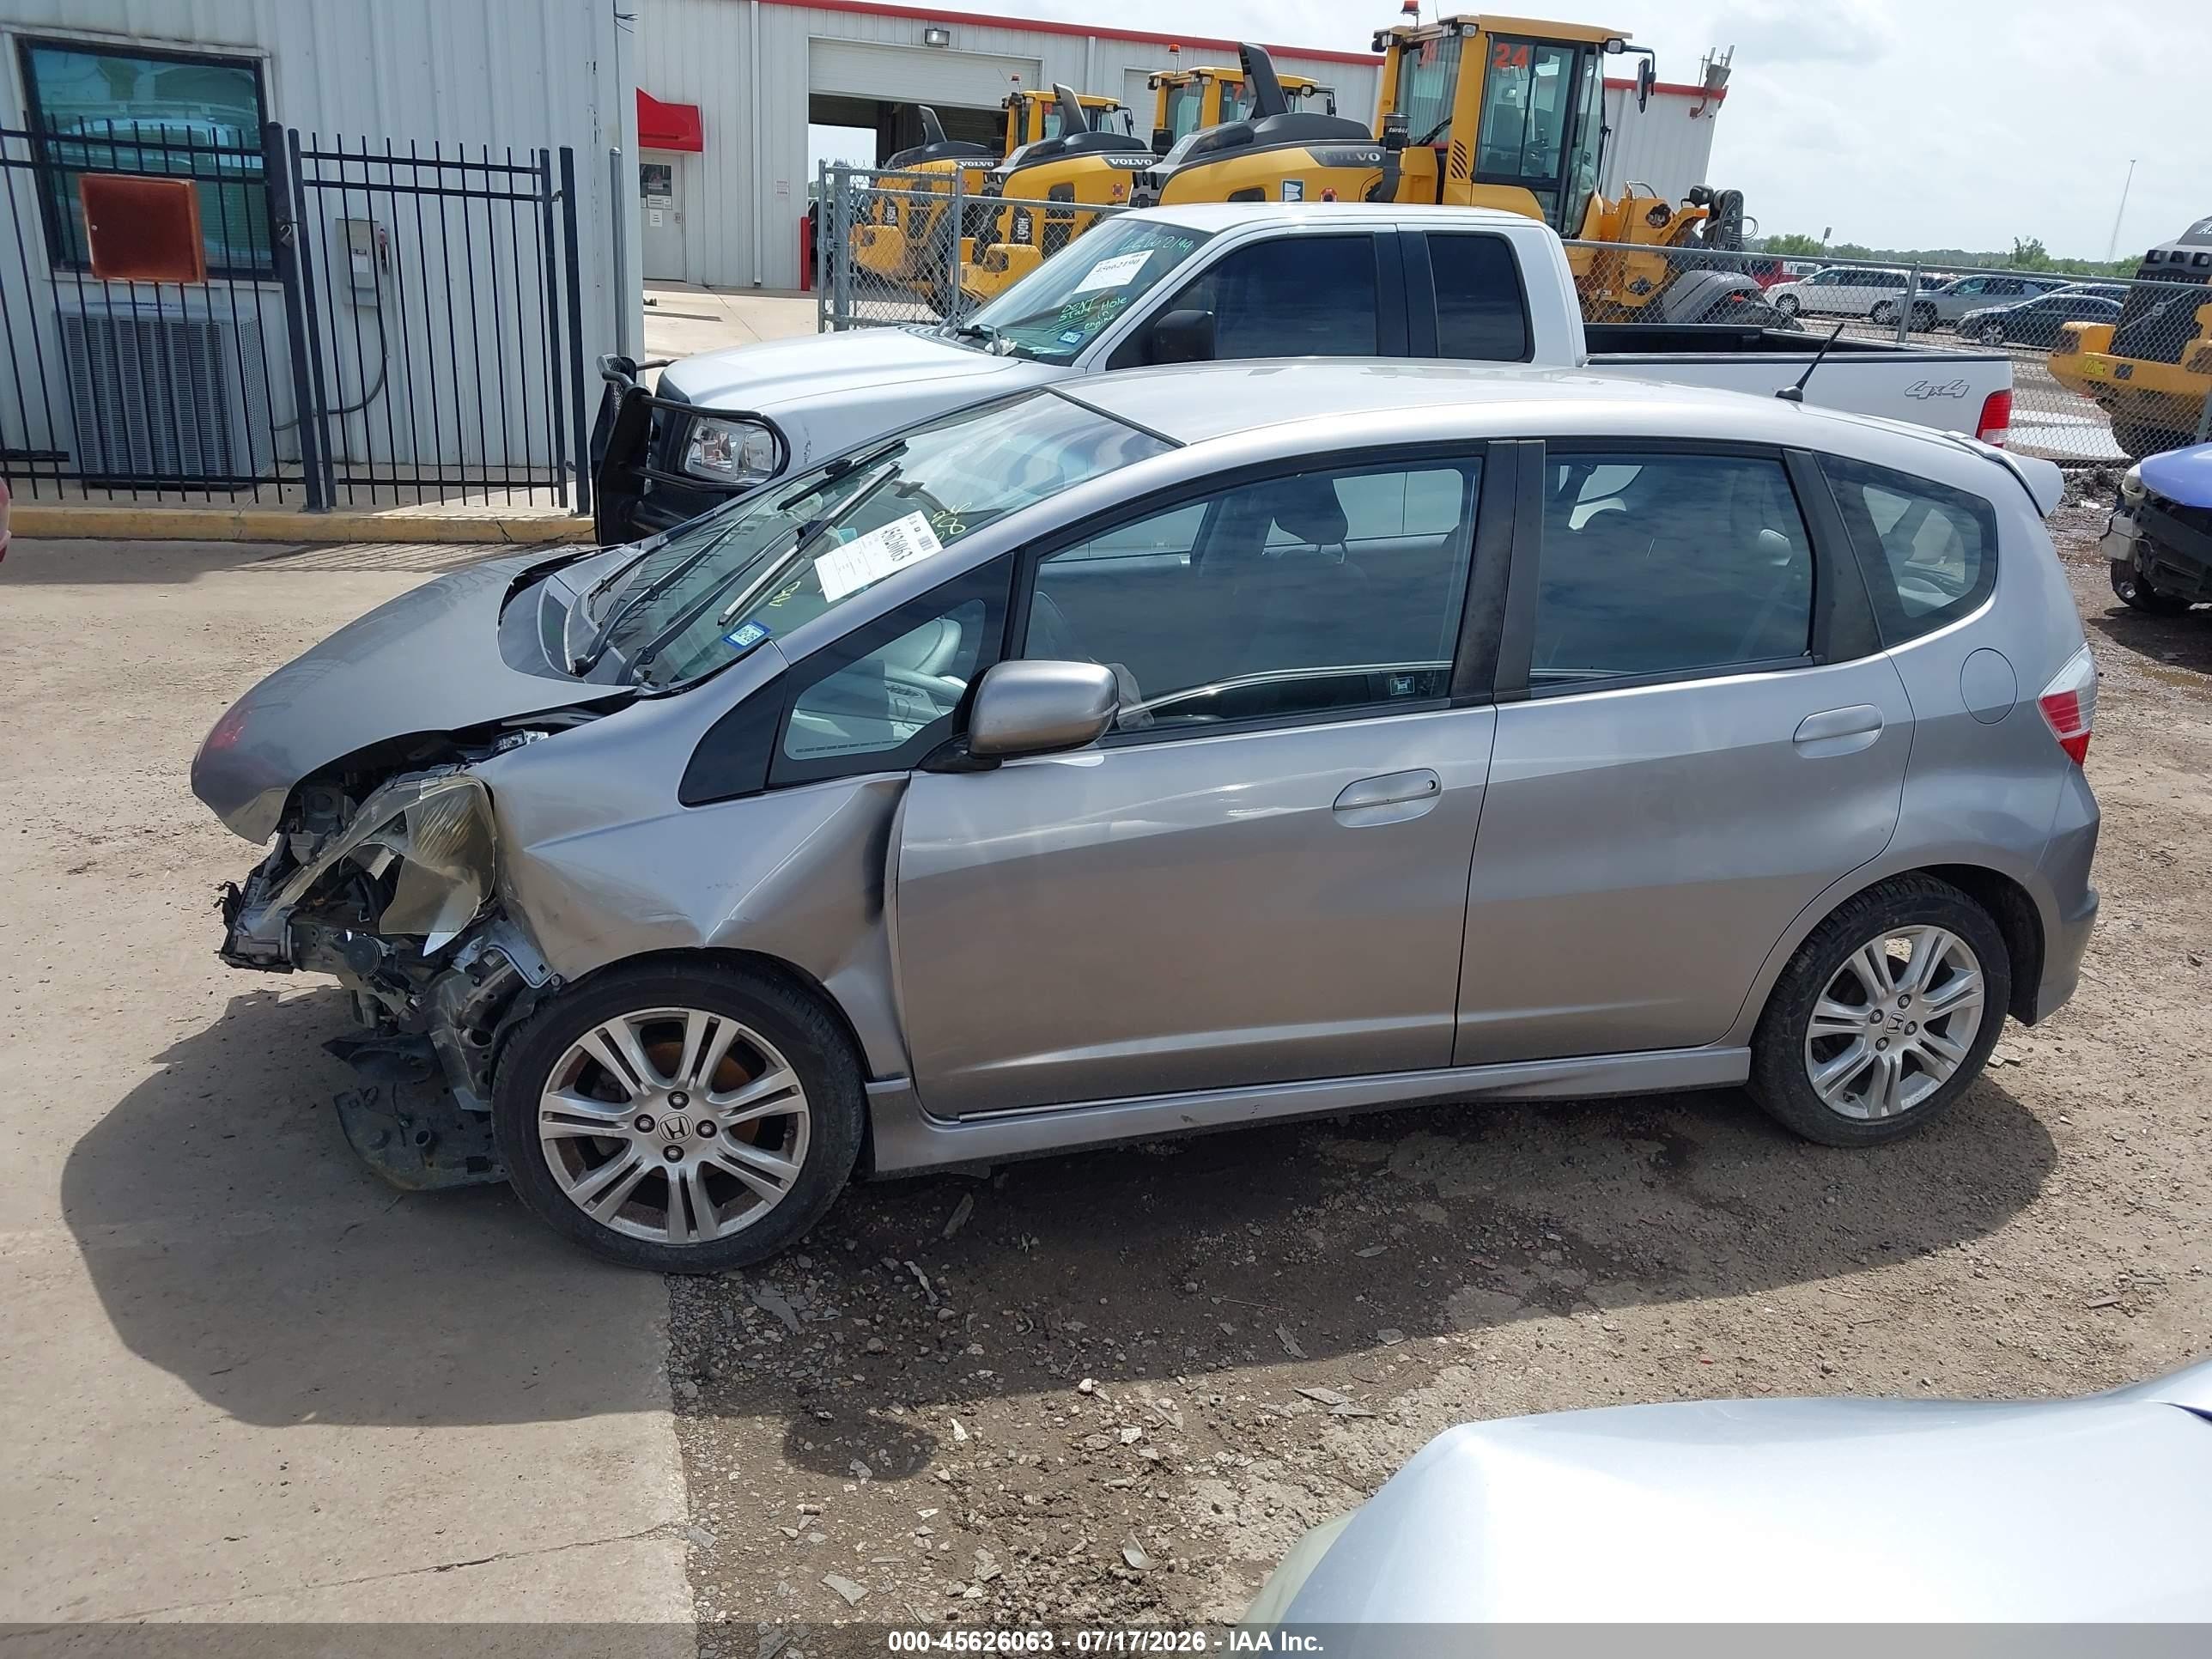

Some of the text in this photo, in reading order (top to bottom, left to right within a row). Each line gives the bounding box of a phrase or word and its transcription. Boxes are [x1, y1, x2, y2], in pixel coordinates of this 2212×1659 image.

[1492, 43, 1528, 69] 24
[1017, 217, 1030, 240] L90H
[1061, 298, 1095, 313] DONT
[1102, 296, 1127, 311] Hole
[1085, 314, 1115, 331] engine
[1097, 310, 1109, 319] in
[1905, 379, 1971, 399] 4x4
[881, 526, 913, 562] 45626063
